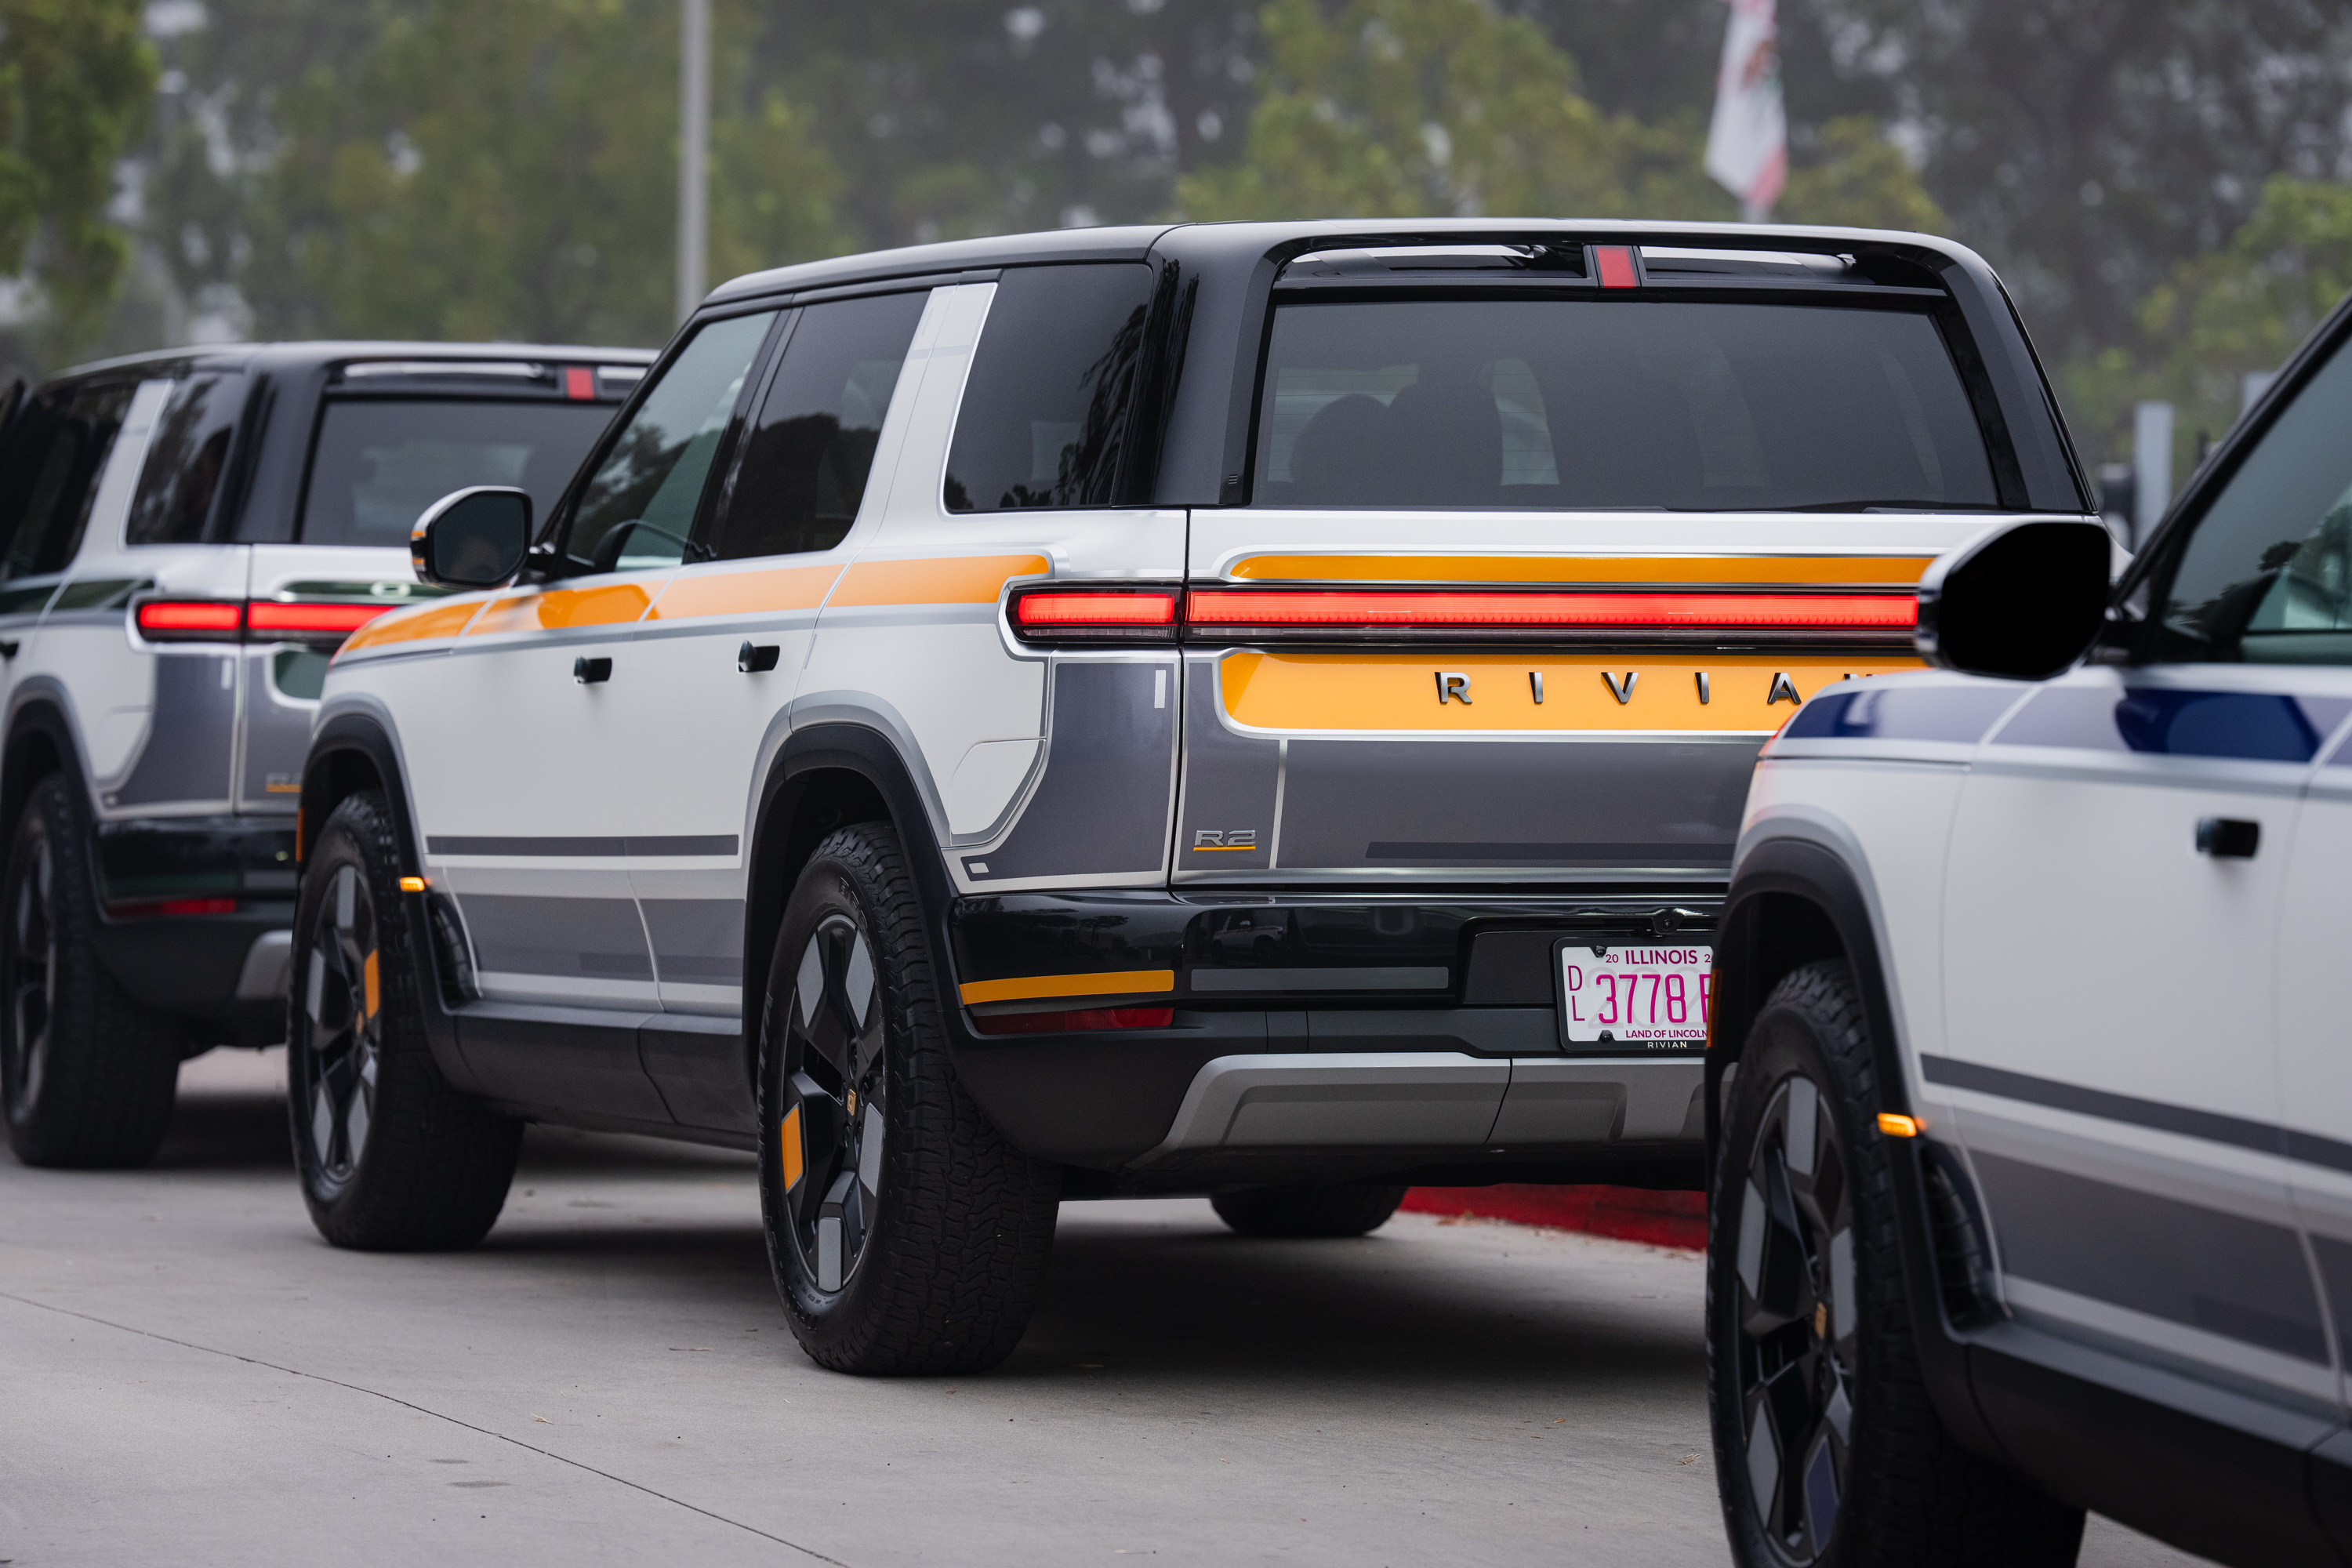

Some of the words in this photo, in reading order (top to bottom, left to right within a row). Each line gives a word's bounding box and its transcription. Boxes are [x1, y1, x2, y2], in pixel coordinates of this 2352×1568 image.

[1434, 672, 1878, 705] RIVIA
[1194, 829, 1256, 847] R2
[1606, 954, 1619, 964] 20
[1625, 949, 1698, 964] ILLINOIS
[1704, 953, 1713, 964] 2
[1625, 1029, 1652, 1039] LAND
[1653, 1029, 1667, 1038] OF
[1668, 1029, 1708, 1038] LINCOLN
